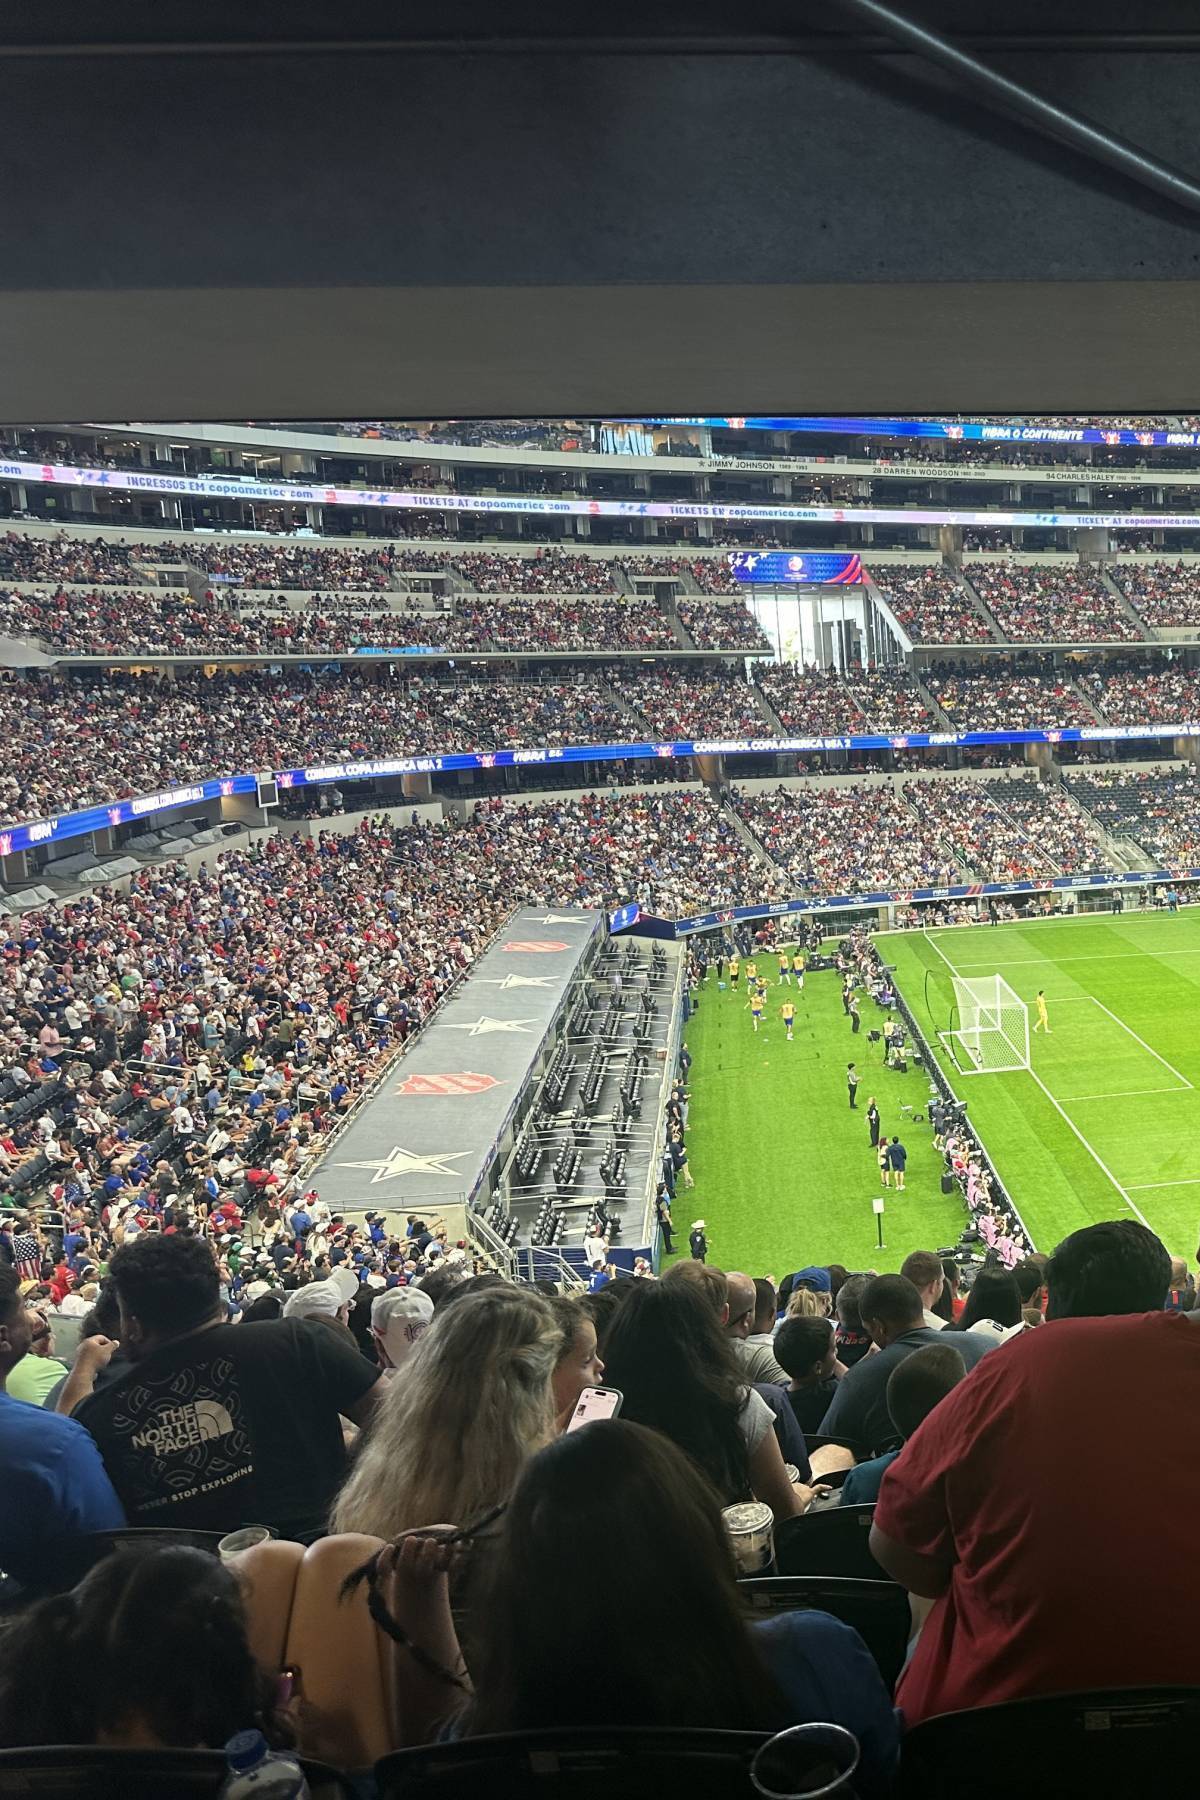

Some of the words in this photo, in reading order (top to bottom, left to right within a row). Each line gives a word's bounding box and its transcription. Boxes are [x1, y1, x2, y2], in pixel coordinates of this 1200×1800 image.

[981, 428, 1011, 438] VIBRA
[1022, 428, 1084, 440] CONTINENTE
[1166, 434, 1195, 445] VIBRA
[707, 461, 733, 469] JIMMY
[735, 462, 775, 470] JOHNSON
[919, 469, 959, 477] WOODSON
[127, 476, 186, 490] INGRESSOS
[189, 483, 205, 491] EM
[412, 496, 454, 507] TICKETS
[458, 498, 470, 507] AT
[670, 506, 709, 516] TICKETS
[712, 507, 725, 516] EN
[729, 509, 817, 519] copaamerica.com
[1112, 517, 1122, 525] AT
[1124, 517, 1200, 527] copaamerica.com
[692, 743, 750, 753] CONMEBOL
[750, 741, 777, 751] COPA
[777, 738, 823, 750] AMERICA
[824, 739, 843, 749] USA
[513, 752, 546, 763] VIBRA
[346, 764, 373, 777] COPA
[373, 759, 416, 774] AMERICA
[417, 759, 434, 770] USA
[435, 758, 442, 769] 2
[158, 1403, 197, 1424] THE
[131, 1416, 199, 1450] NORTH
[153, 1428, 201, 1456] FACE
[171, 1487, 199, 1502] STOP
